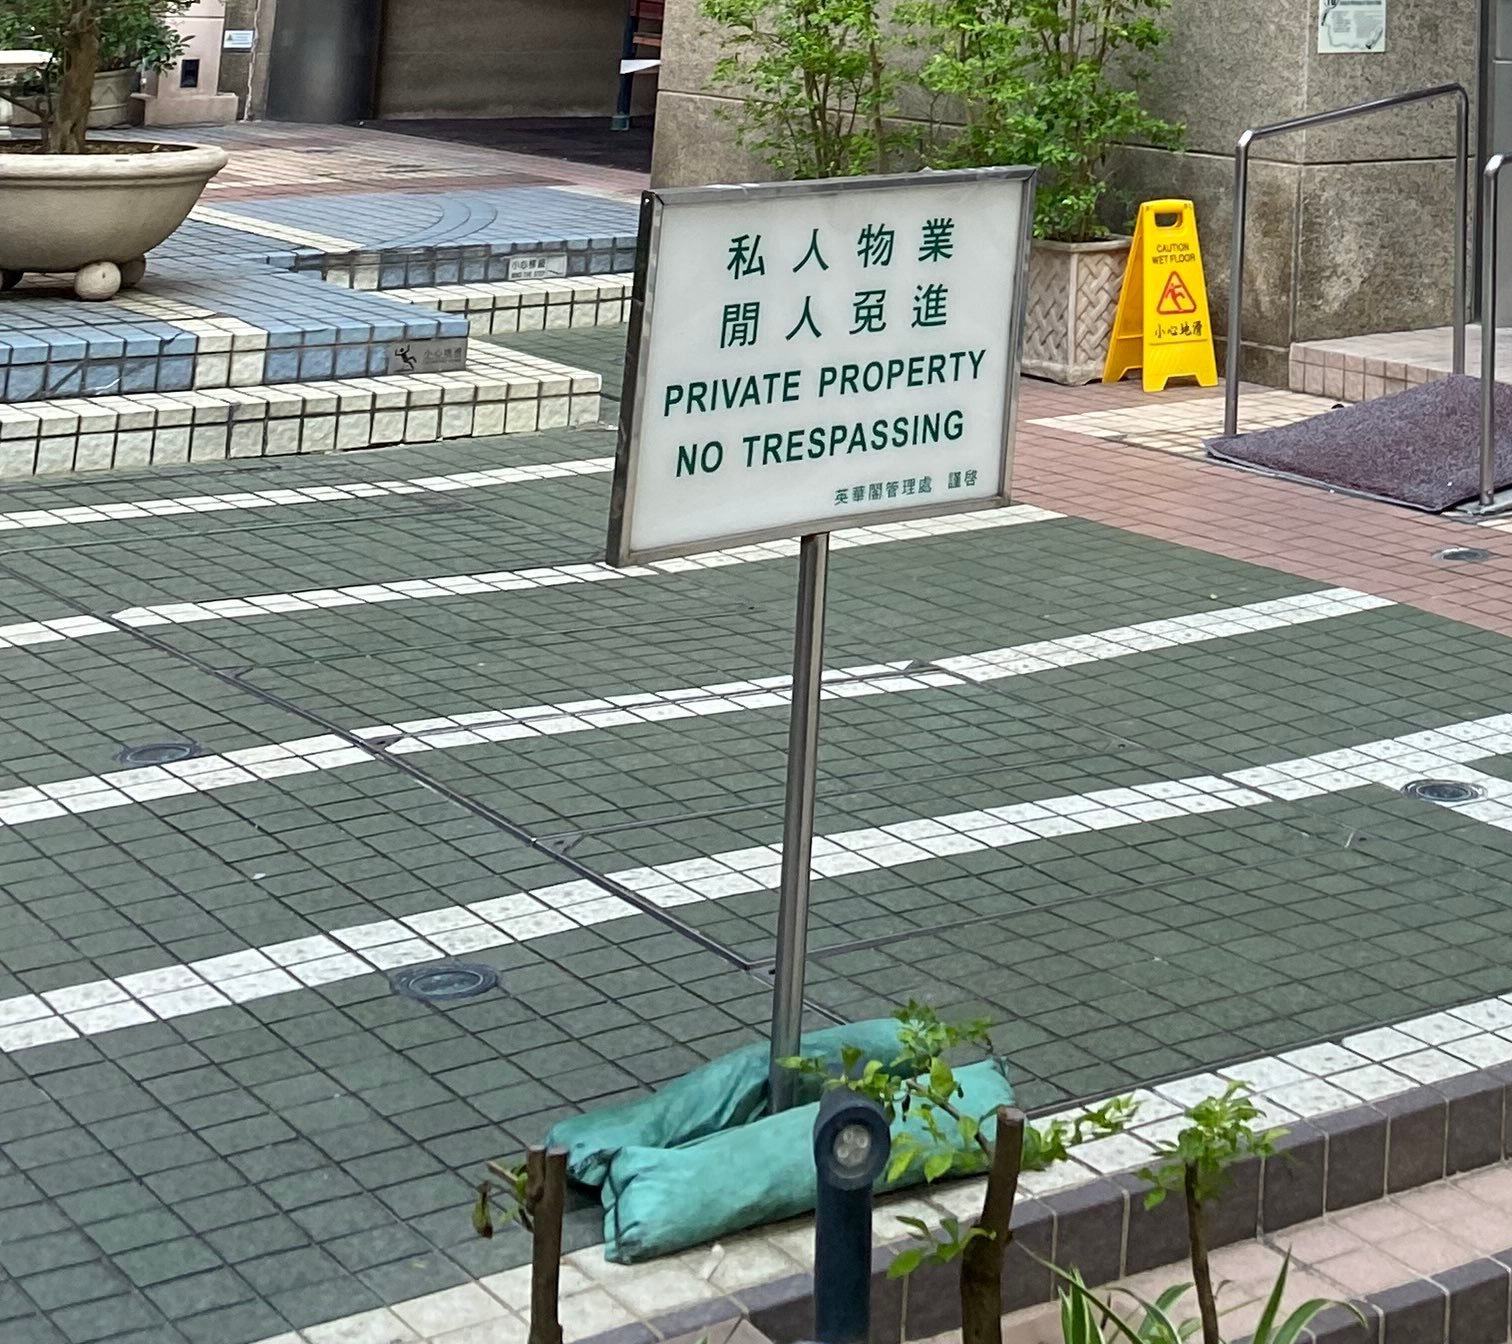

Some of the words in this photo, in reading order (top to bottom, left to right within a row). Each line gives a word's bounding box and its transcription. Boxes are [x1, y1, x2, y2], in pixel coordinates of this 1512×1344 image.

[726, 217, 955, 280] 私人物業
[1152, 254, 1169, 264] WET
[1170, 252, 1196, 263] FLOOR
[1156, 243, 1190, 253] CAUTION
[719, 283, 949, 349] 閒人免進
[1154, 320, 1203, 339] 小心地滑
[663, 369, 802, 417] PRIVATE
[818, 348, 988, 398] PROPERTY
[675, 440, 724, 478] NO
[741, 409, 965, 469] TRESPASSING
[833, 475, 933, 506] 英華閣管理處
